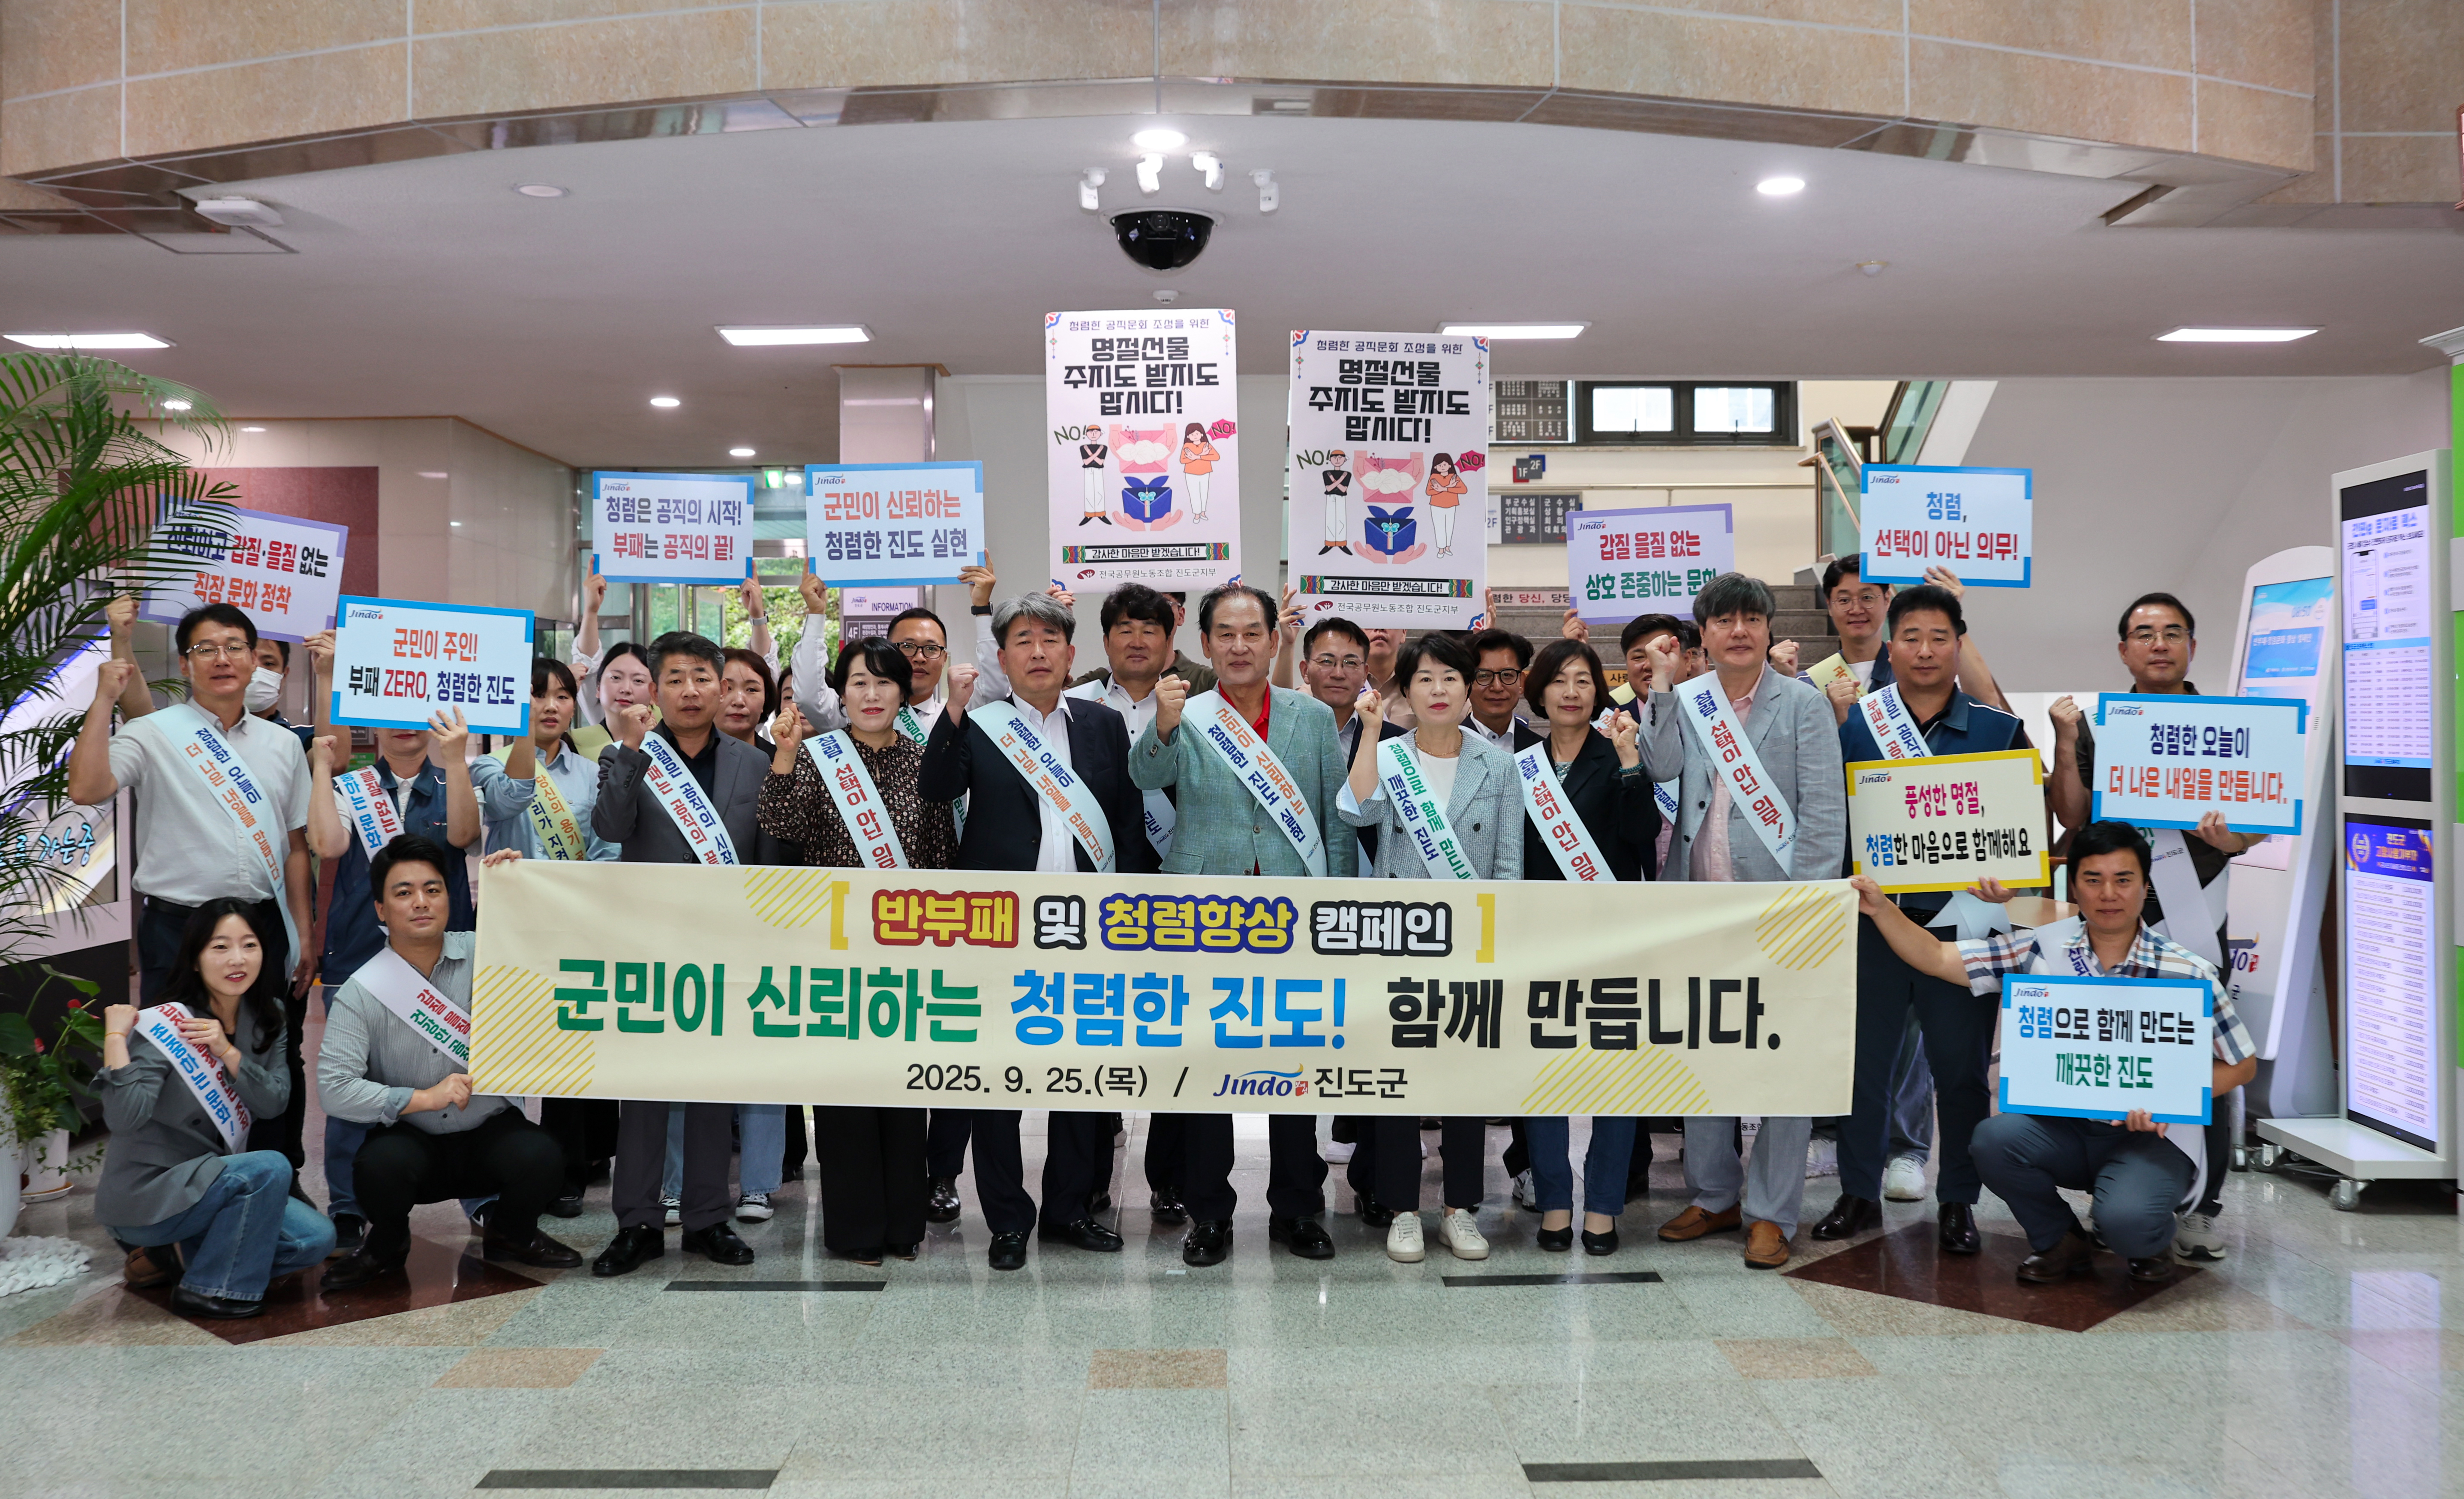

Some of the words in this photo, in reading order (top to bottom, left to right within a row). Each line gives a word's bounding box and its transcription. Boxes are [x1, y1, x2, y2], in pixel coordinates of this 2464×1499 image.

[1069, 320, 1101, 331] 청렴한
[1106, 319, 1147, 330] 공직문화
[1153, 319, 1184, 329] 조성을
[1189, 319, 1209, 328] 위한
[1092, 337, 1189, 361] 명절선물
[1317, 340, 1349, 352] 청렴한
[1355, 340, 1398, 352] 공직문화
[1404, 343, 1436, 354] 조성을
[1441, 343, 1463, 355] 위한
[1064, 364, 1137, 388] 주지도
[1146, 363, 1219, 387] 받지도
[1339, 359, 1441, 386] 명절선물
[1100, 391, 1182, 415] 맙시다!
[1309, 387, 1385, 412] 주지도
[1394, 388, 1470, 415] 받지도
[1054, 425, 1087, 445] NO!
[1211, 422, 1236, 436] NO!
[1346, 416, 1431, 443] 맙시다!
[1296, 449, 1331, 470] NO!
[1459, 455, 1485, 468] NO!
[1518, 467, 1528, 477] 1F
[1530, 460, 1541, 470] 2F
[602, 484, 625, 492] Jindo
[815, 476, 840, 485] Jindo
[1870, 476, 1895, 484] Jindo
[606, 496, 652, 523] 청렴은
[657, 498, 701, 525] 공직의
[707, 500, 742, 526] 시작!
[824, 491, 879, 521] 군민이
[886, 489, 961, 519] 신뢰하는
[1926, 492, 1967, 523] 청렴,
[1578, 521, 1602, 531] Jindo
[613, 533, 658, 559] 부패는
[664, 534, 708, 560] 공직의
[714, 535, 733, 561] 끝!
[825, 530, 882, 560] 청렴한
[888, 530, 925, 558] 진도
[931, 528, 968, 558] 실현
[1091, 548, 1120, 559] 감사한
[1122, 548, 1149, 559] 마음만
[1151, 547, 1200, 558] 받겠습니다!
[1600, 533, 1630, 560] 갑질
[1635, 532, 1665, 559] 을질
[1670, 530, 1701, 557] 없는
[1875, 529, 1928, 558] 선택이
[1935, 531, 1970, 559] 아닌
[1977, 533, 2018, 561] 의무!
[299, 546, 329, 578] 없는
[1099, 569, 1172, 579] 전국공무원노동조합
[1176, 568, 1217, 578] 진도군지부
[194, 572, 225, 604] 직장
[227, 577, 258, 610] 문화
[261, 582, 292, 615] 정착
[1331, 580, 1359, 591] 감사한
[1362, 581, 1390, 591] 마음만
[1392, 581, 1442, 593] 받겠습니다!
[1519, 594, 1545, 603] 당신,
[1586, 573, 1616, 600] 상호
[1621, 570, 1682, 599] 존중하는
[348, 609, 377, 620] Jindo
[872, 602, 913, 611] INFORMATION
[1337, 602, 1414, 614] 전국공무원노동조합
[1417, 605, 1459, 614] 진도군지부
[394, 628, 438, 659] 군민이
[443, 632, 478, 662] 주인!
[848, 627, 858, 639] 4F
[349, 665, 380, 697] 부패
[384, 669, 430, 702] ZERO,
[437, 671, 481, 703] 청렴한
[486, 675, 515, 704] 진도
[1867, 699, 1891, 737] 부패는
[2108, 706, 2138, 716] Jindo
[1008, 717, 1042, 751] 청렴한
[1041, 752, 1074, 788] 오늘이
[2150, 723, 2198, 756] 청렴한
[2202, 726, 2250, 759] 오늘이
[195, 728, 232, 764] 청렴한
[228, 766, 262, 804] 오늘이
[1215, 708, 1255, 748] 군민이
[1256, 750, 1305, 816] 신뢰하는
[1711, 720, 1742, 763] 선택이
[1733, 763, 1761, 796] 아닌
[645, 740, 682, 779] 청렴은
[679, 782, 716, 828] 공직의
[815, 735, 843, 763] 청렴,
[835, 763, 868, 806] 선택이
[856, 809, 883, 841] 아닌
[1208, 724, 1249, 769] 청렴한
[1248, 771, 1280, 806] 진도
[1280, 808, 1306, 843] 실현
[1388, 743, 1427, 796] 청렴으로
[1420, 801, 1445, 833] 함께
[1859, 775, 1886, 784] Jindo
[2109, 765, 2124, 796] 더
[2129, 766, 2160, 798] 나은
[2166, 768, 2213, 801] 내일을
[2219, 770, 2288, 804] 만듭니다.
[185, 743, 204, 758] 더
[199, 759, 226, 787] 나은
[222, 788, 257, 828] 내일을
[252, 830, 281, 882] 만듭니다
[360, 771, 383, 797] 을질
[374, 799, 398, 834] 없는
[535, 774, 565, 813] 당신의
[560, 819, 580, 846] 용기
[999, 733, 1016, 748] 더
[1013, 748, 1039, 775] 나은
[1036, 774, 1071, 812] 내일을
[1069, 812, 1104, 862] 만듭니다
[1905, 783, 1947, 819] 풍성한
[1951, 781, 1984, 817] 명절,
[359, 813, 383, 849] 문화
[670, 798, 707, 845] 공직의
[1388, 774, 1419, 822] 깨끗한
[1414, 827, 1439, 861] 진도
[1532, 780, 1561, 820] 선택이
[1552, 820, 1581, 852] 아닌
[1866, 833, 1908, 867] 청렴한
[1912, 830, 1969, 864] 마음으로
[1973, 828, 2031, 861] 함께해요
[874, 891, 1018, 946] 반부패
[1036, 897, 1085, 948] 및
[1102, 895, 1295, 951] 청렴향상
[1312, 902, 1450, 954] 캠페인
[554, 959, 725, 1036] 군민이
[747, 966, 982, 1043] 신뢰하는
[1011, 969, 1190, 1047] 청렴한
[1209, 976, 1346, 1049] 진도!
[1387, 976, 1503, 1049] 함께
[1527, 976, 1781, 1051] 만듭니다.
[2014, 987, 2043, 997] Jindo
[410, 1009, 451, 1044] 건강한
[417, 989, 447, 1015] 갑질
[444, 1011, 471, 1035] 을질
[2019, 1005, 2090, 1040] 청렴으로
[2097, 1008, 2133, 1042] 함께
[2139, 1011, 2195, 1045] 만드는
[149, 1023, 210, 1090] 존중하는
[2056, 1053, 2111, 1087] 깨끗한
[2117, 1056, 2154, 1089] 진도
[907, 1063, 991, 1093] 2025.
[1004, 1066, 1032, 1094] 9.
[1046, 1064, 1148, 1098] 25.(목)
[1213, 1072, 1293, 1098] Jindo
[1313, 1067, 1408, 1099] 진도군
